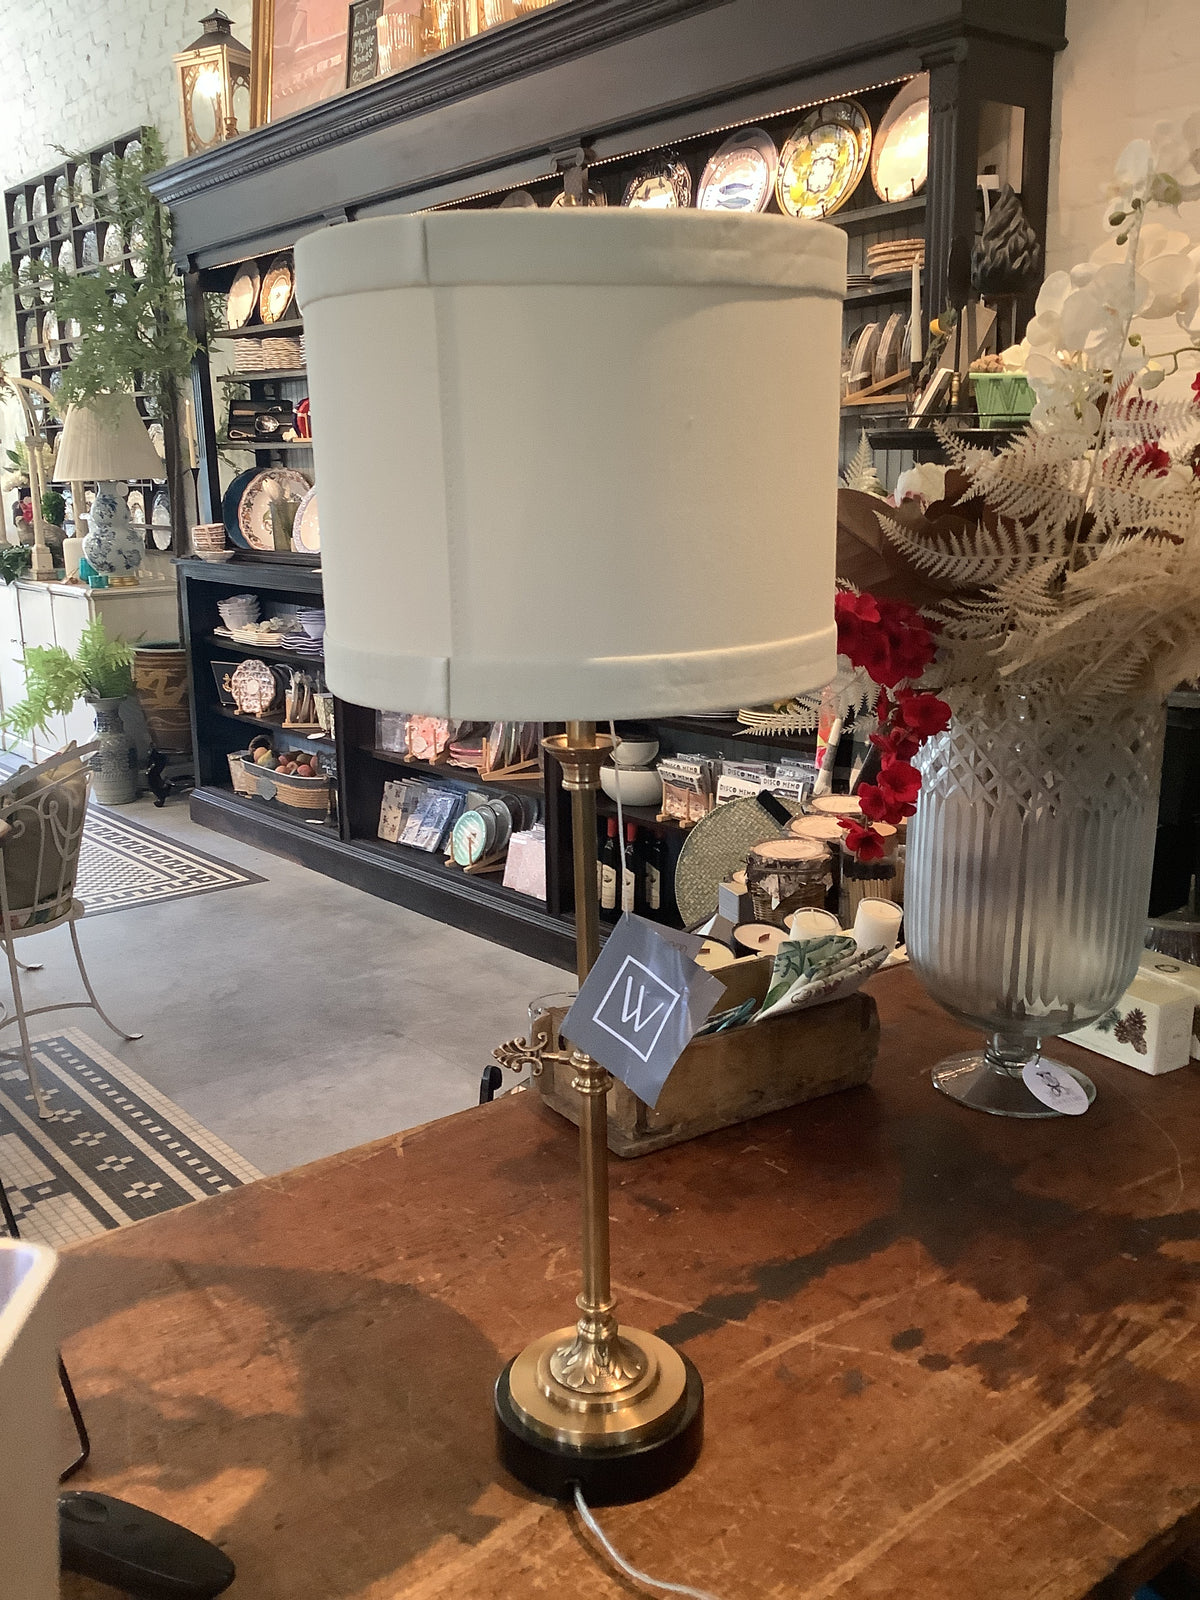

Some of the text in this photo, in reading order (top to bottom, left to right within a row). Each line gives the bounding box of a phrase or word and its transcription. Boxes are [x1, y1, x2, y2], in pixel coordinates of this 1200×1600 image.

[659, 769, 694, 783] DISCO MEMO
[727, 768, 745, 777] DISCO
[720, 784, 756, 796] DISCO MEMO
[763, 778, 800, 790] DISCO MEMO
[621, 976, 664, 1032] W
